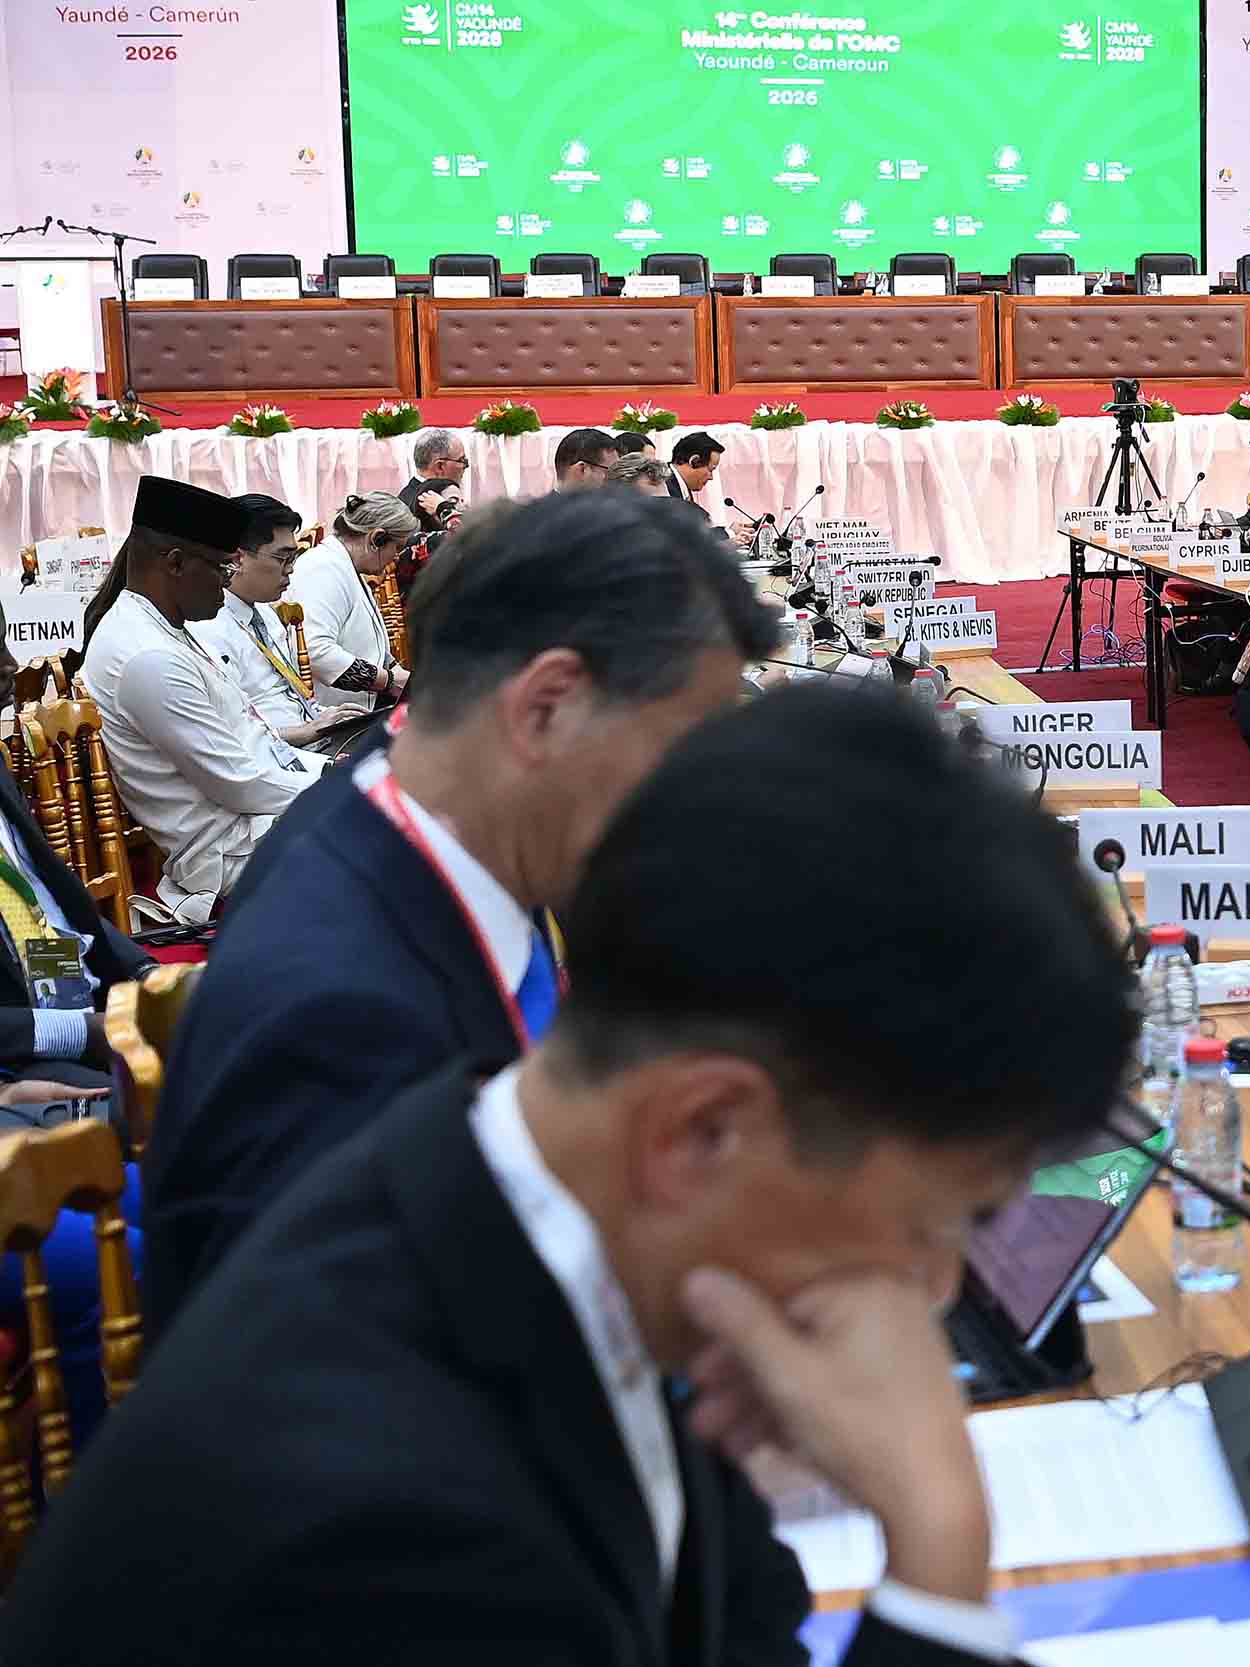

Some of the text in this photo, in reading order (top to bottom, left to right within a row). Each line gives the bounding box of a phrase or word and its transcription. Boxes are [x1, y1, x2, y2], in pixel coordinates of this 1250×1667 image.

[55, 5, 129, 23] Yaundé
[149, 5, 240, 23] Camerún
[808, 34, 834, 51] de
[125, 45, 177, 61] 2026
[694, 52, 775, 70] Yaoundé
[791, 53, 889, 71] Cameroun
[768, 90, 818, 105] 2026
[1179, 544, 1229, 558] CYPRUS
[858, 570, 930, 584] SWITZERLD
[921, 622, 950, 641] KITTS
[953, 621, 960, 638] &
[963, 618, 992, 637] NEVIS
[1012, 713, 1094, 732] NIGER
[1001, 743, 1149, 769] MONGOLIA
[1140, 821, 1225, 857] MALI
